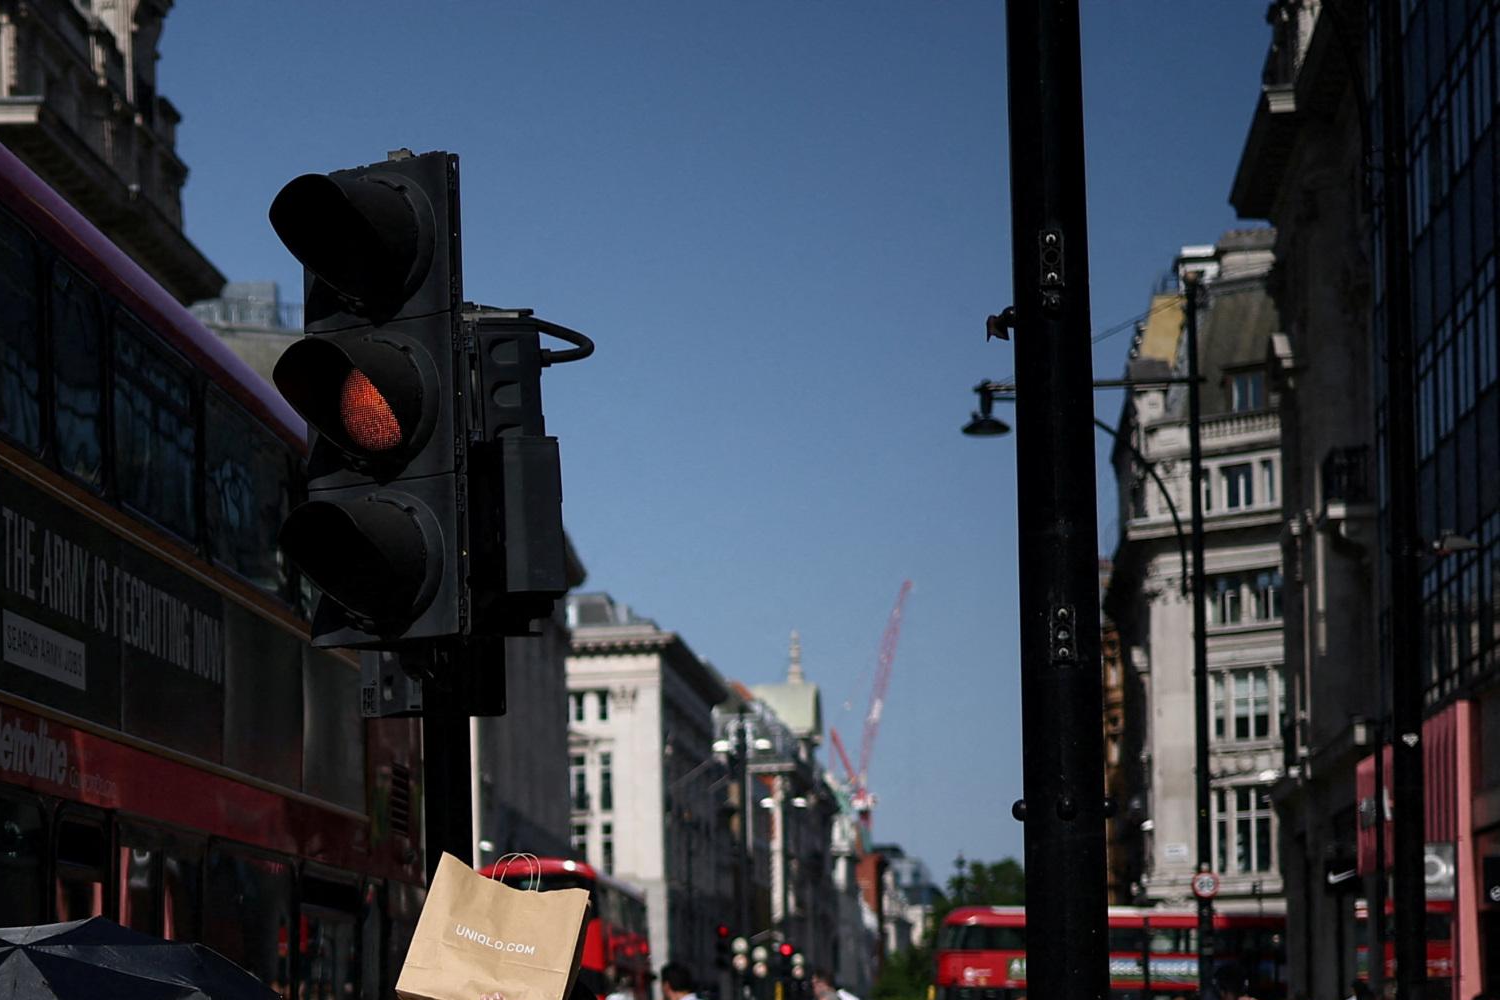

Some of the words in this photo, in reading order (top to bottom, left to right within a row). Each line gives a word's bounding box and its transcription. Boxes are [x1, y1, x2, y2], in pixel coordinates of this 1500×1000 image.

[2, 504, 36, 600] THE
[41, 528, 90, 624] ARMY
[93, 555, 108, 633] IS
[112, 565, 190, 671] RECRUITING
[6, 624, 38, 659] SEARCH
[455, 924, 536, 955] UNIQLO.COM
